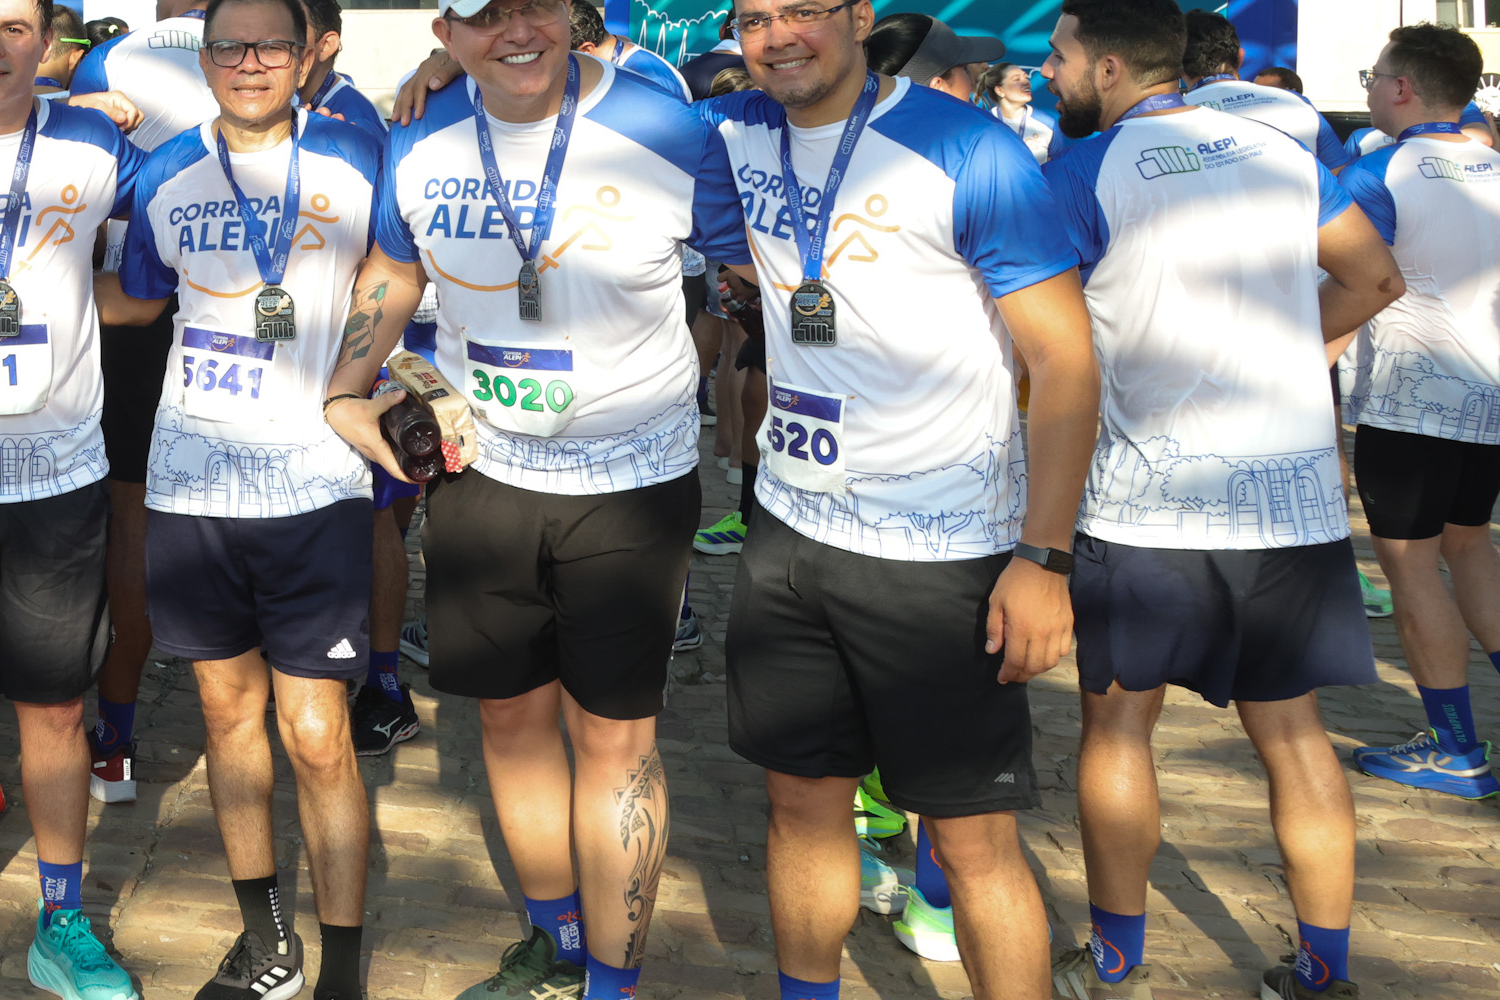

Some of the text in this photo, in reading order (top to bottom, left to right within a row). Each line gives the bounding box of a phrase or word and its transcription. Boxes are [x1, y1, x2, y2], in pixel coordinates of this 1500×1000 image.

[1221, 93, 1255, 104] ALEPI
[1197, 136, 1238, 155] ALEPI
[1202, 150, 1236, 163] ASSEMBLEIA
[1215, 158, 1238, 168] ESTADO
[1464, 163, 1493, 173] ALEPI
[424, 177, 548, 201] CORRID
[170, 195, 281, 226] CORRDA
[503, 354, 522, 362] ALEPI
[183, 355, 263, 399] 5641
[473, 369, 574, 413] 3020
[767, 416, 838, 466] 520
[45, 877, 56, 901] ALEPI
[559, 925, 573, 950] CORRIDA
[569, 921, 581, 949] ALEPI
